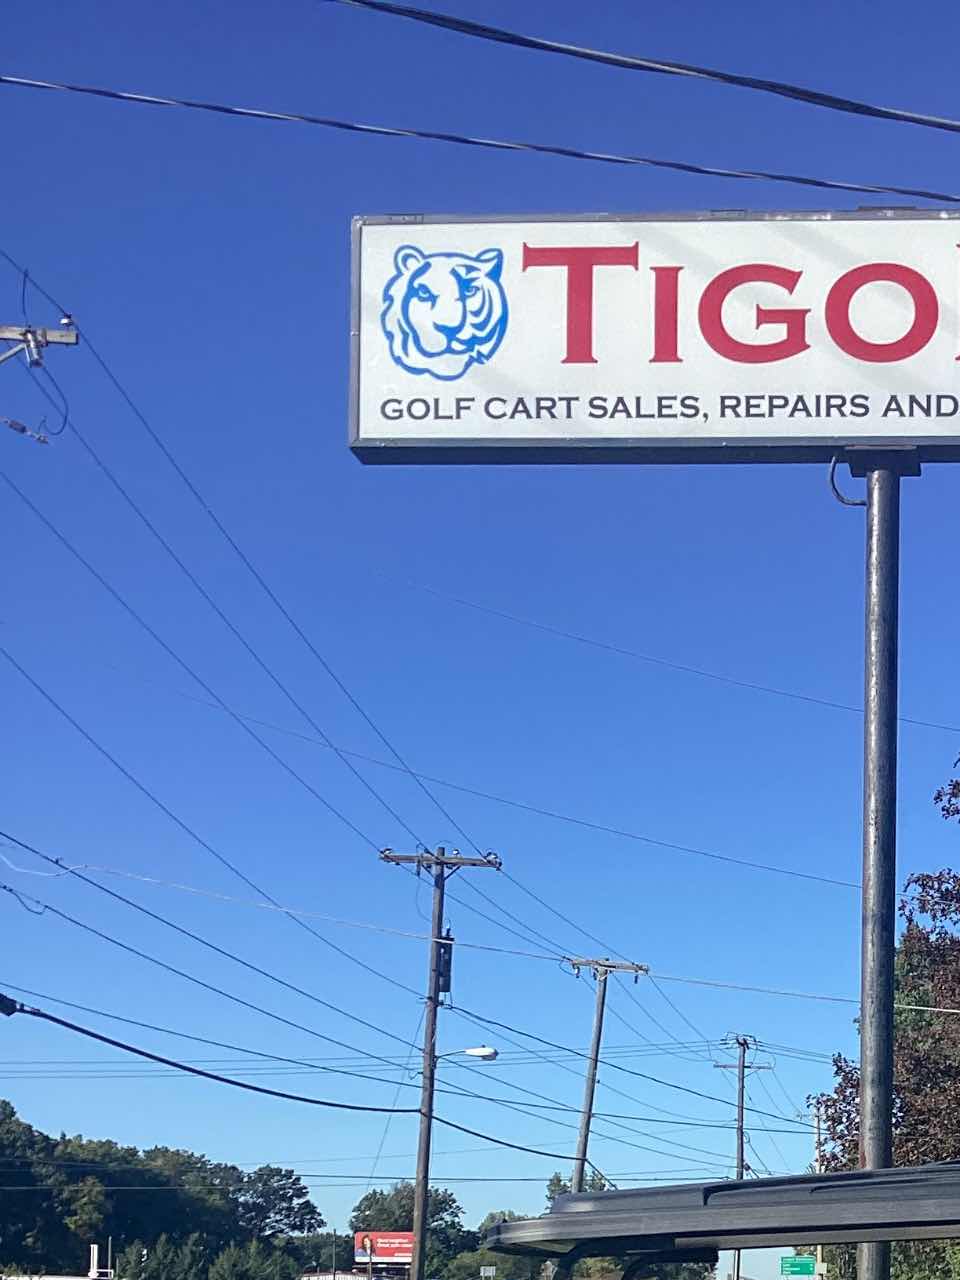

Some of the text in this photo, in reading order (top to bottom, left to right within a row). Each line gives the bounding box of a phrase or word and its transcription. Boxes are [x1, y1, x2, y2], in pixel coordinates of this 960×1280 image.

[380, 397, 475, 421] GOLF
[484, 396, 580, 420] CART
[588, 395, 709, 422] SALES,
[719, 394, 870, 418] REPAIRS
[882, 393, 959, 418] AND
